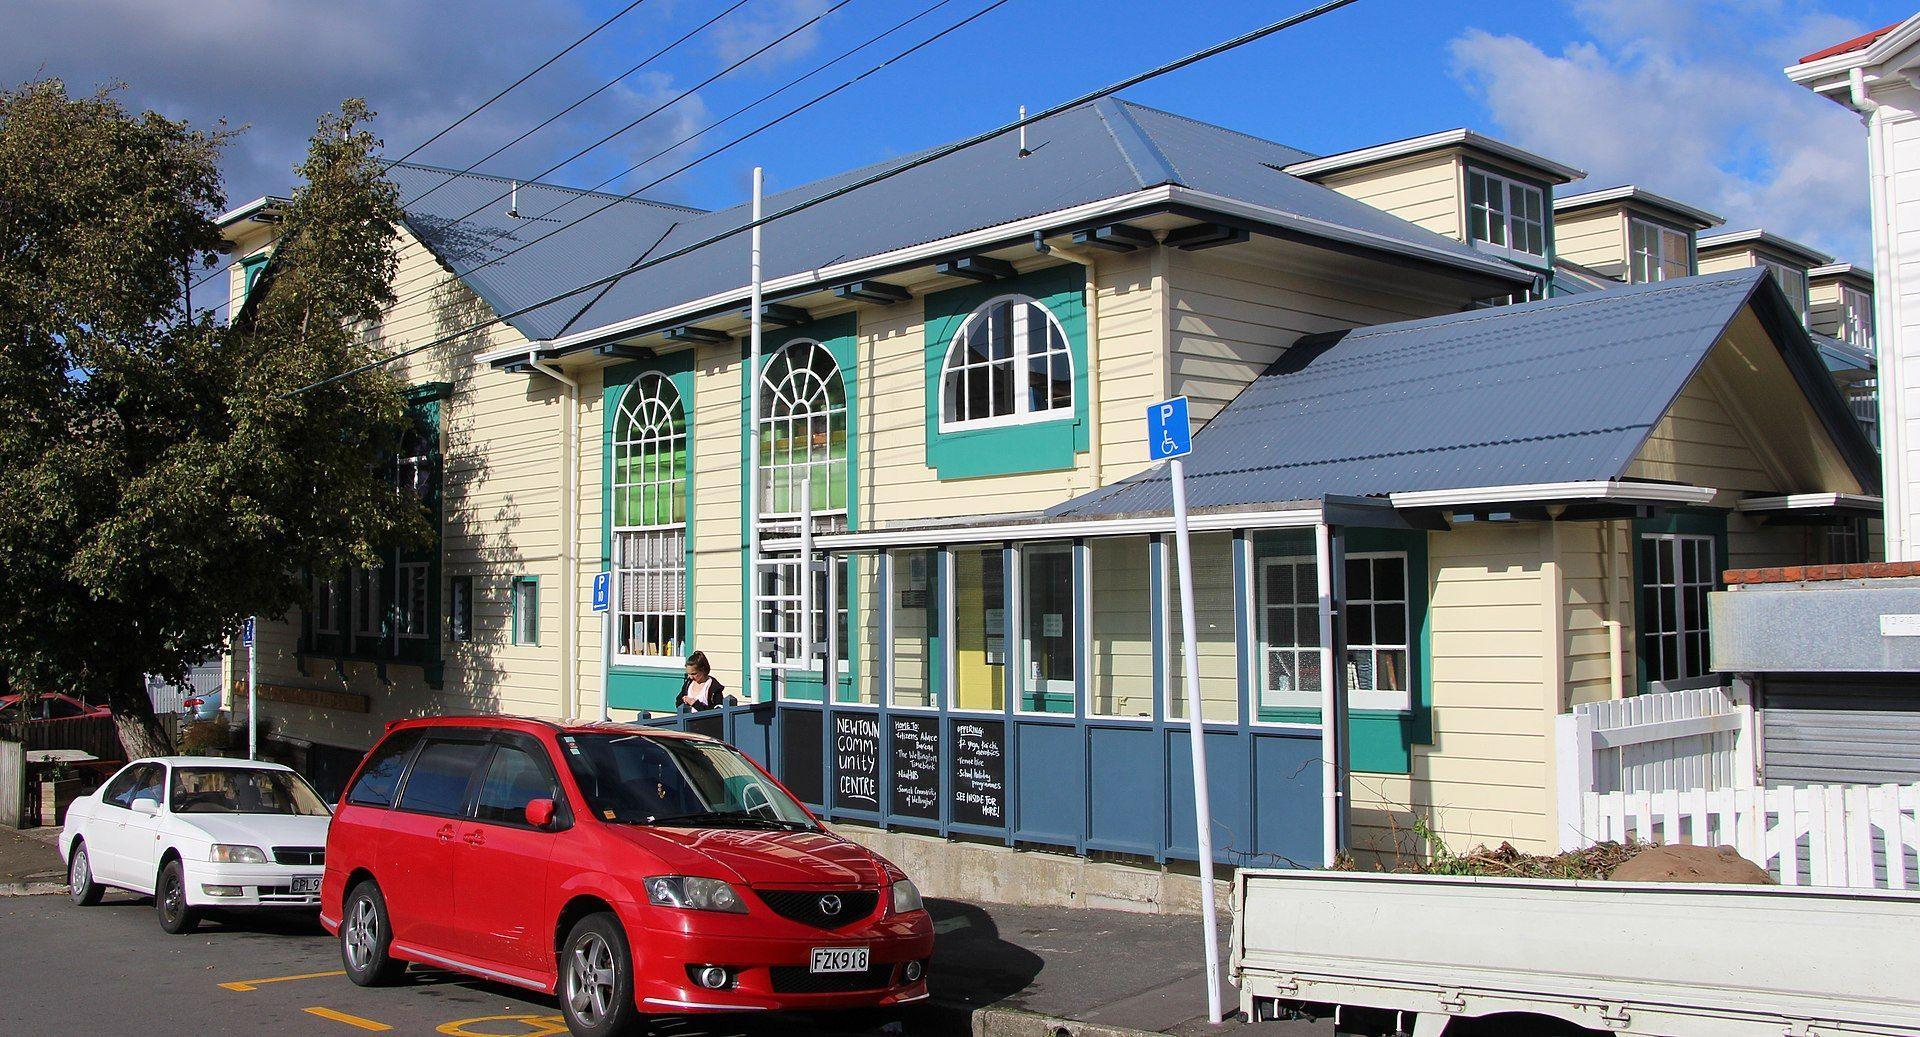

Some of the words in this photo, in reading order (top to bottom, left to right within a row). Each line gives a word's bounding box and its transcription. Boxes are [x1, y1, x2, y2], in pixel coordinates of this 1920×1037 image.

[1161, 404, 1174, 427] P
[599, 575, 605, 590] P
[837, 718, 880, 739] NEWTOWN
[894, 721, 910, 731] HOME
[908, 750, 938, 763] Wellington
[840, 775, 876, 796] CENTRE
[956, 791, 966, 802] SEE
[966, 792, 984, 805] INSIDE
[982, 805, 1000, 818] MORE!
[813, 951, 868, 970] FZK918
